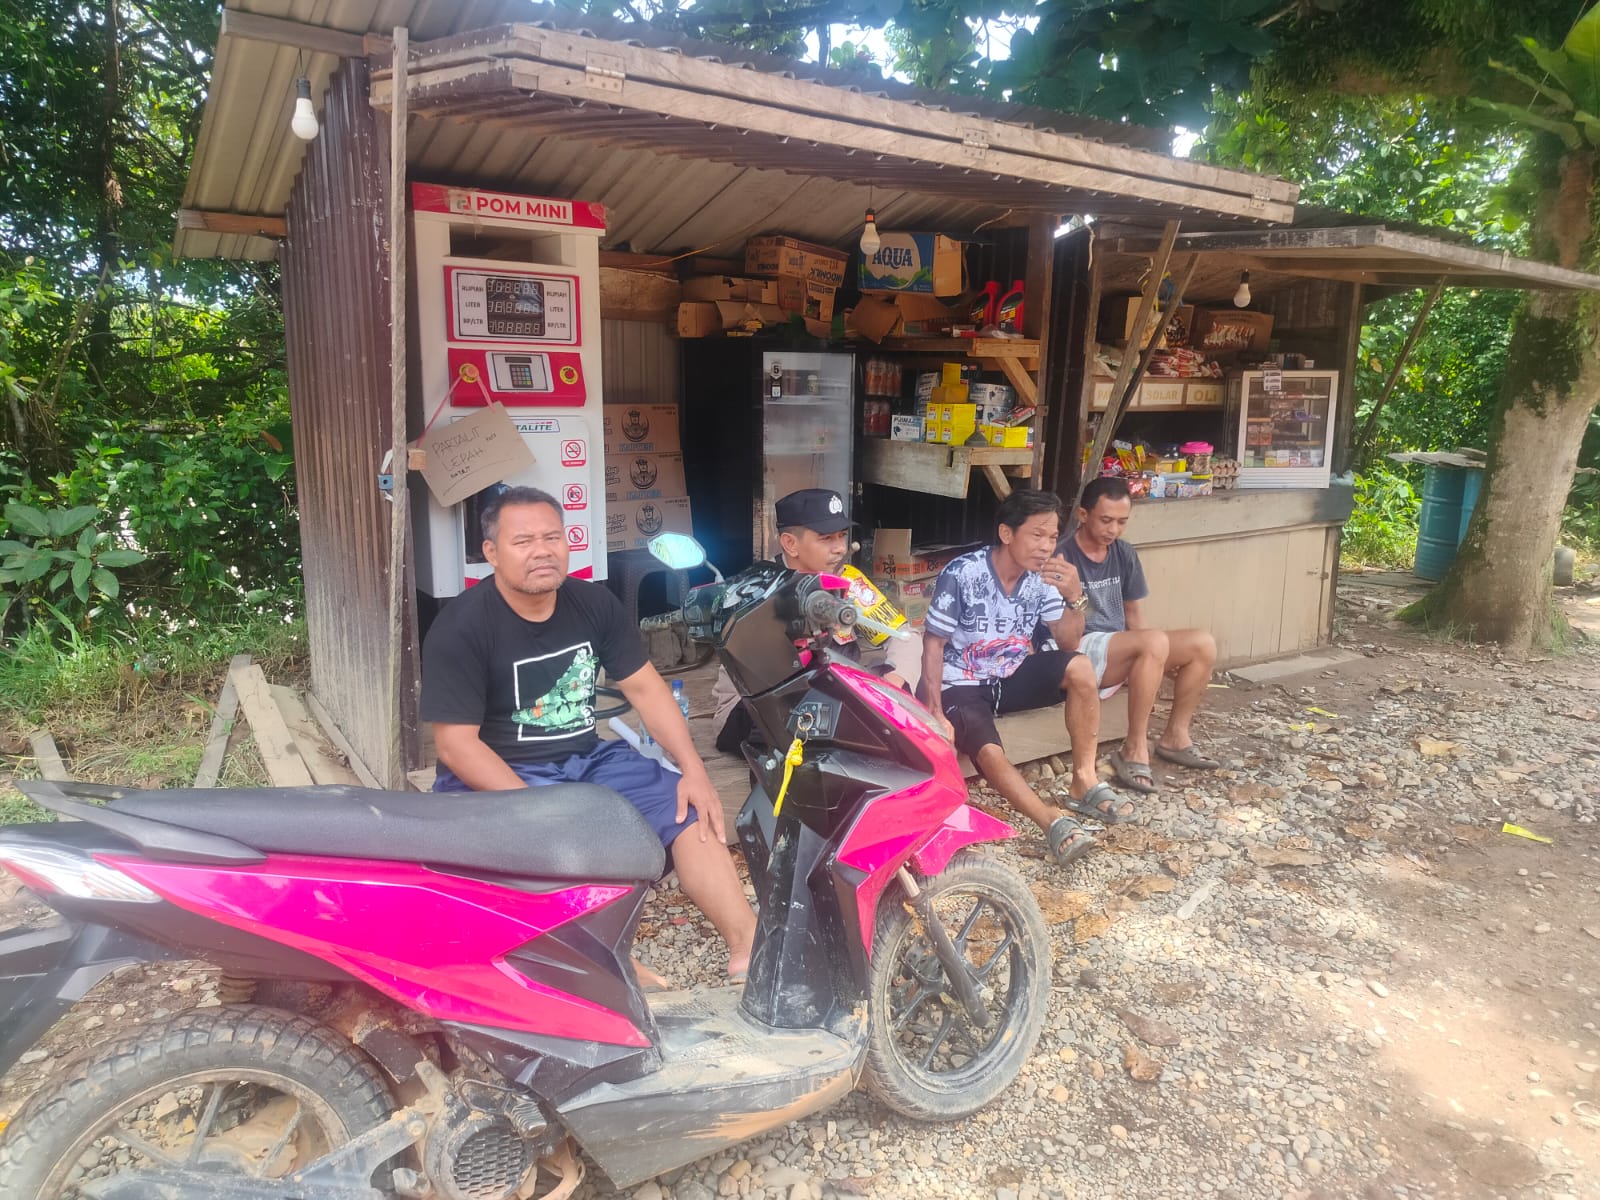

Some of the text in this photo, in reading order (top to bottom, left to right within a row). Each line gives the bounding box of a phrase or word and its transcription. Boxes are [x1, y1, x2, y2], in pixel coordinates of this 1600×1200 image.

[477, 196, 567, 219] POM MINI
[872, 246, 913, 269] AQUA
[1146, 389, 1178, 401] SOLAR
[977, 612, 1034, 634] GEAR
